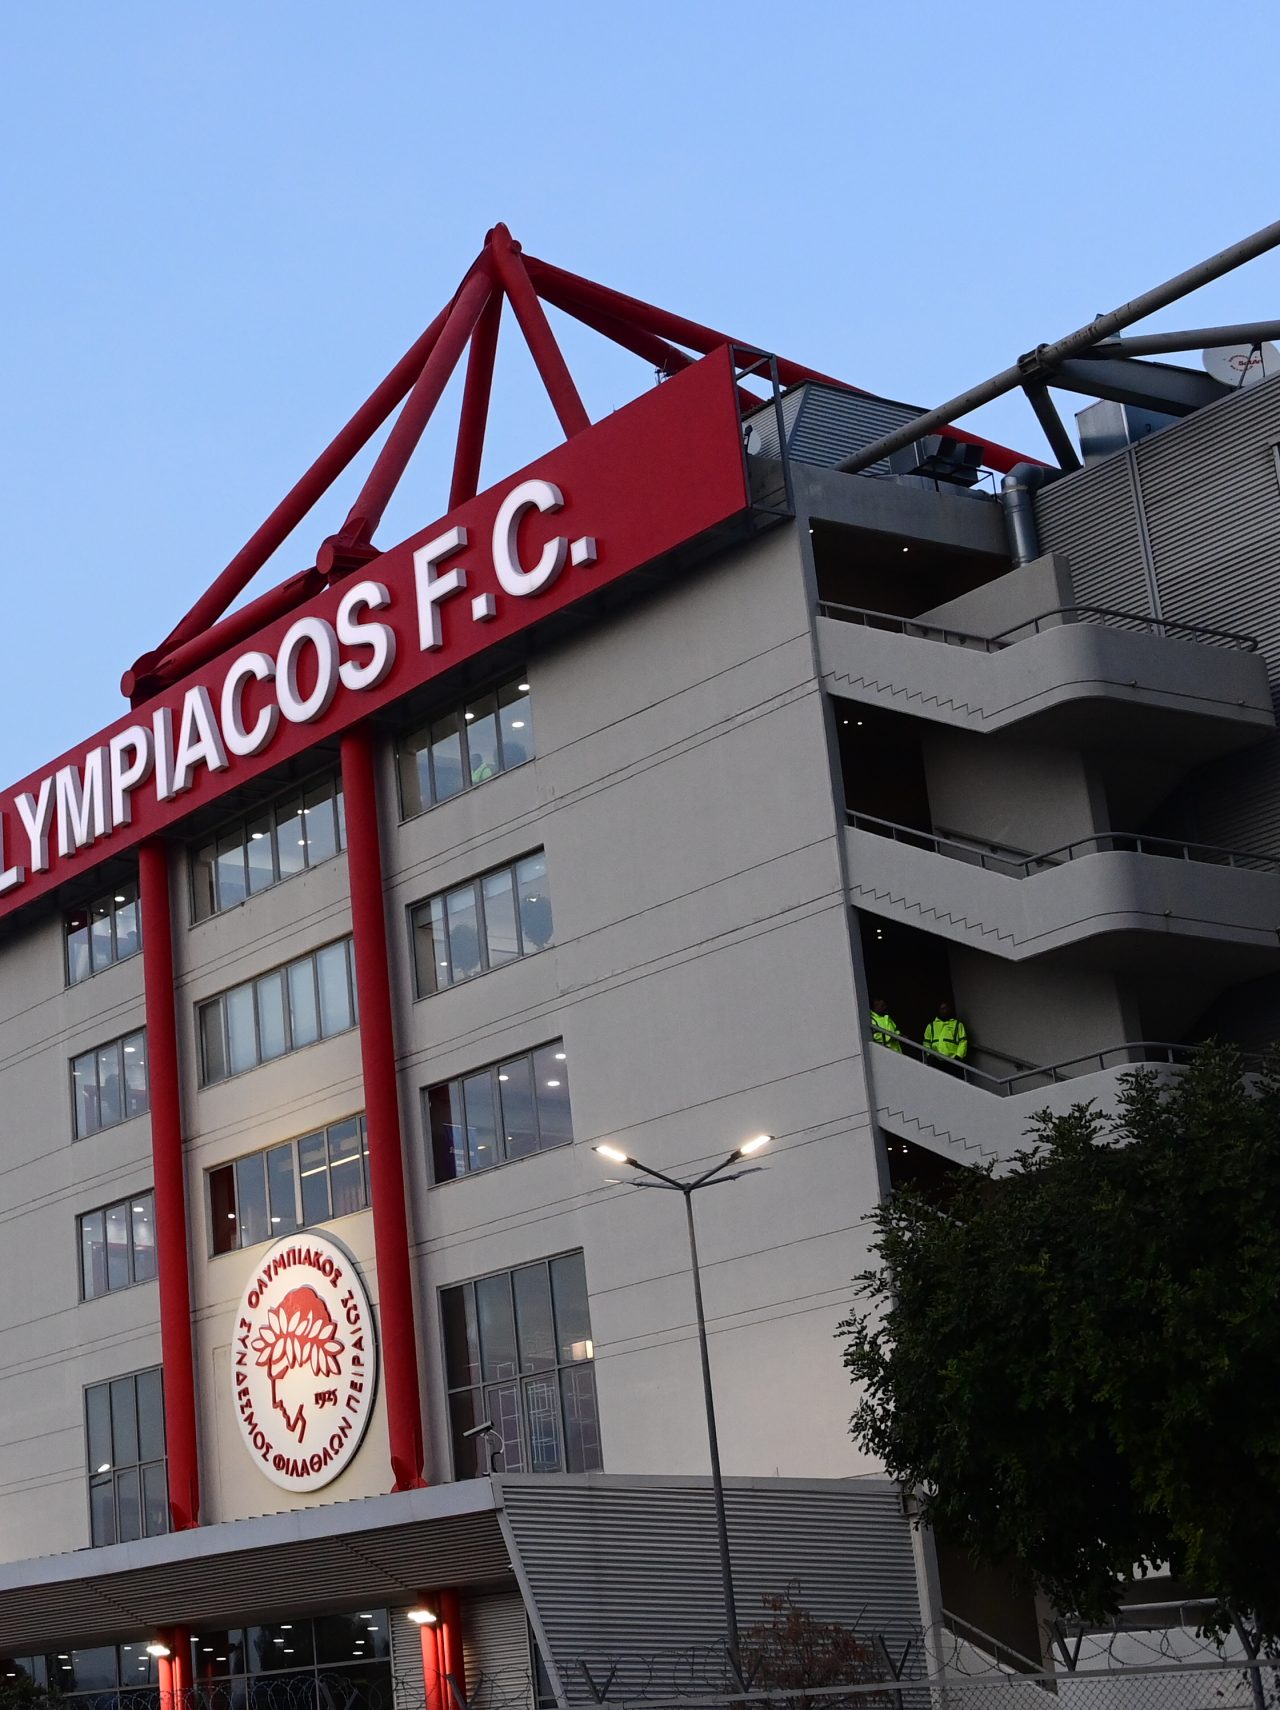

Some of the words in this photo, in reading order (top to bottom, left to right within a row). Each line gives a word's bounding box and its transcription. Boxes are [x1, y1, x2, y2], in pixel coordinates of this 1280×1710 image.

[413, 479, 597, 652] F.C.
[247, 1246, 343, 1309] ΟΛΥΜΠΙΑΚΟΣ
[236, 1317, 274, 1462] ΣΥΝΔΕΣΜΟΣ
[272, 1416, 353, 1478] ΦΙΛΑΘΛΩΝ
[340, 1289, 365, 1413] ΠΕΙΡΑΙΩΣ
[314, 1388, 338, 1409] 1925
